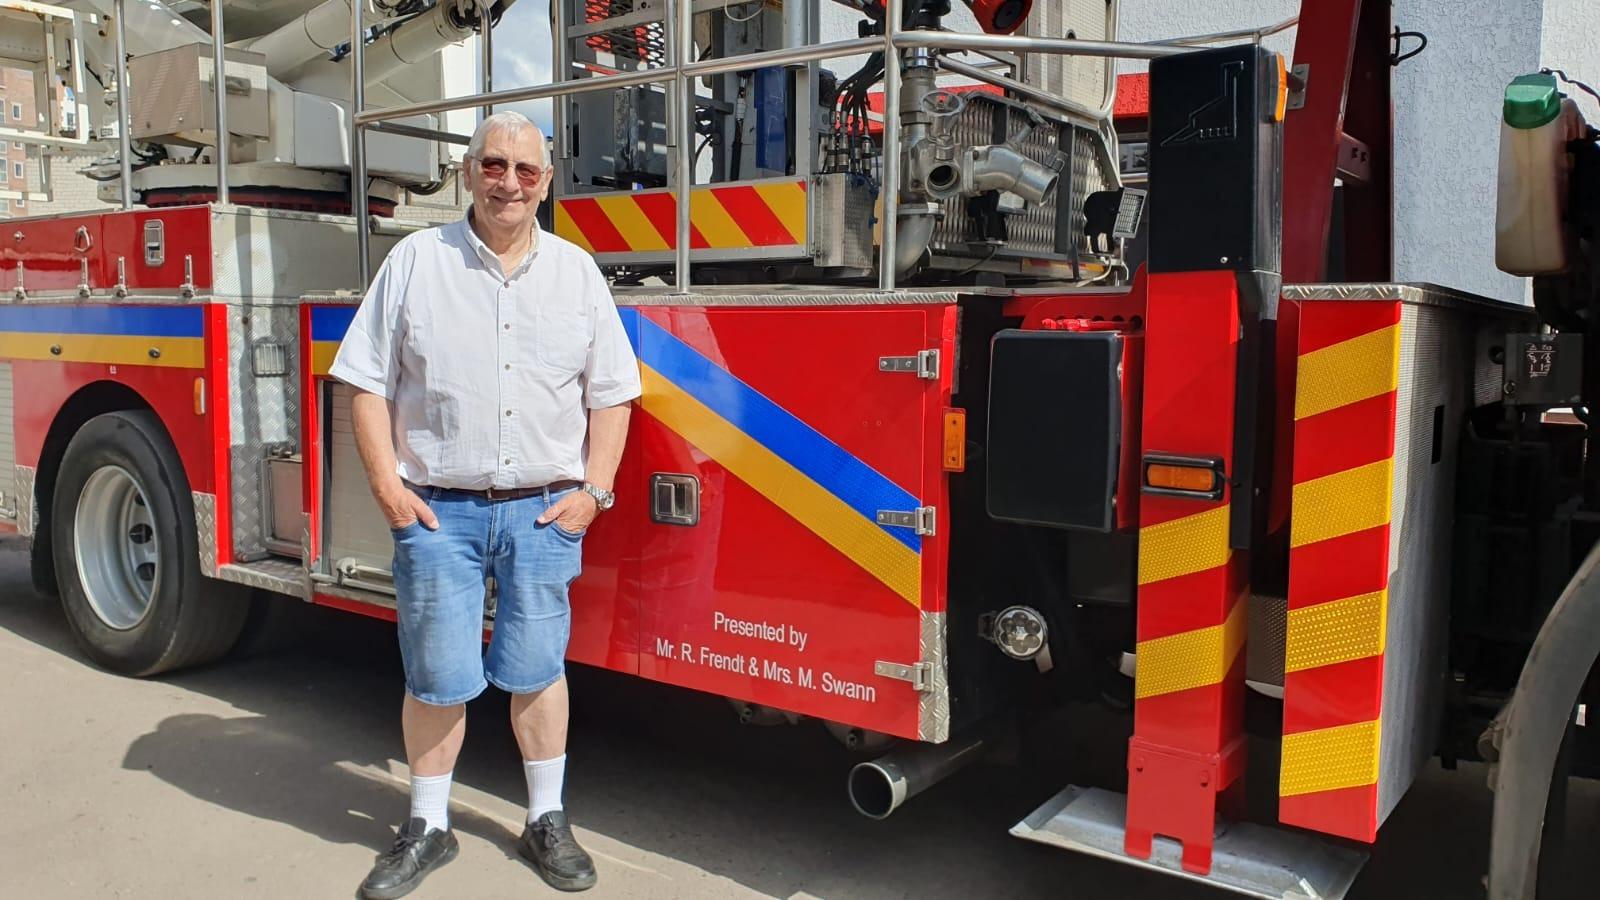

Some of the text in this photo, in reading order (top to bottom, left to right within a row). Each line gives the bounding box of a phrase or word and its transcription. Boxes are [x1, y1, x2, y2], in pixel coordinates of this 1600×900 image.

[714, 611, 808, 652] Presented by
[656, 637, 876, 702] Mr. R. Frendt & Mrs. M. Swann
